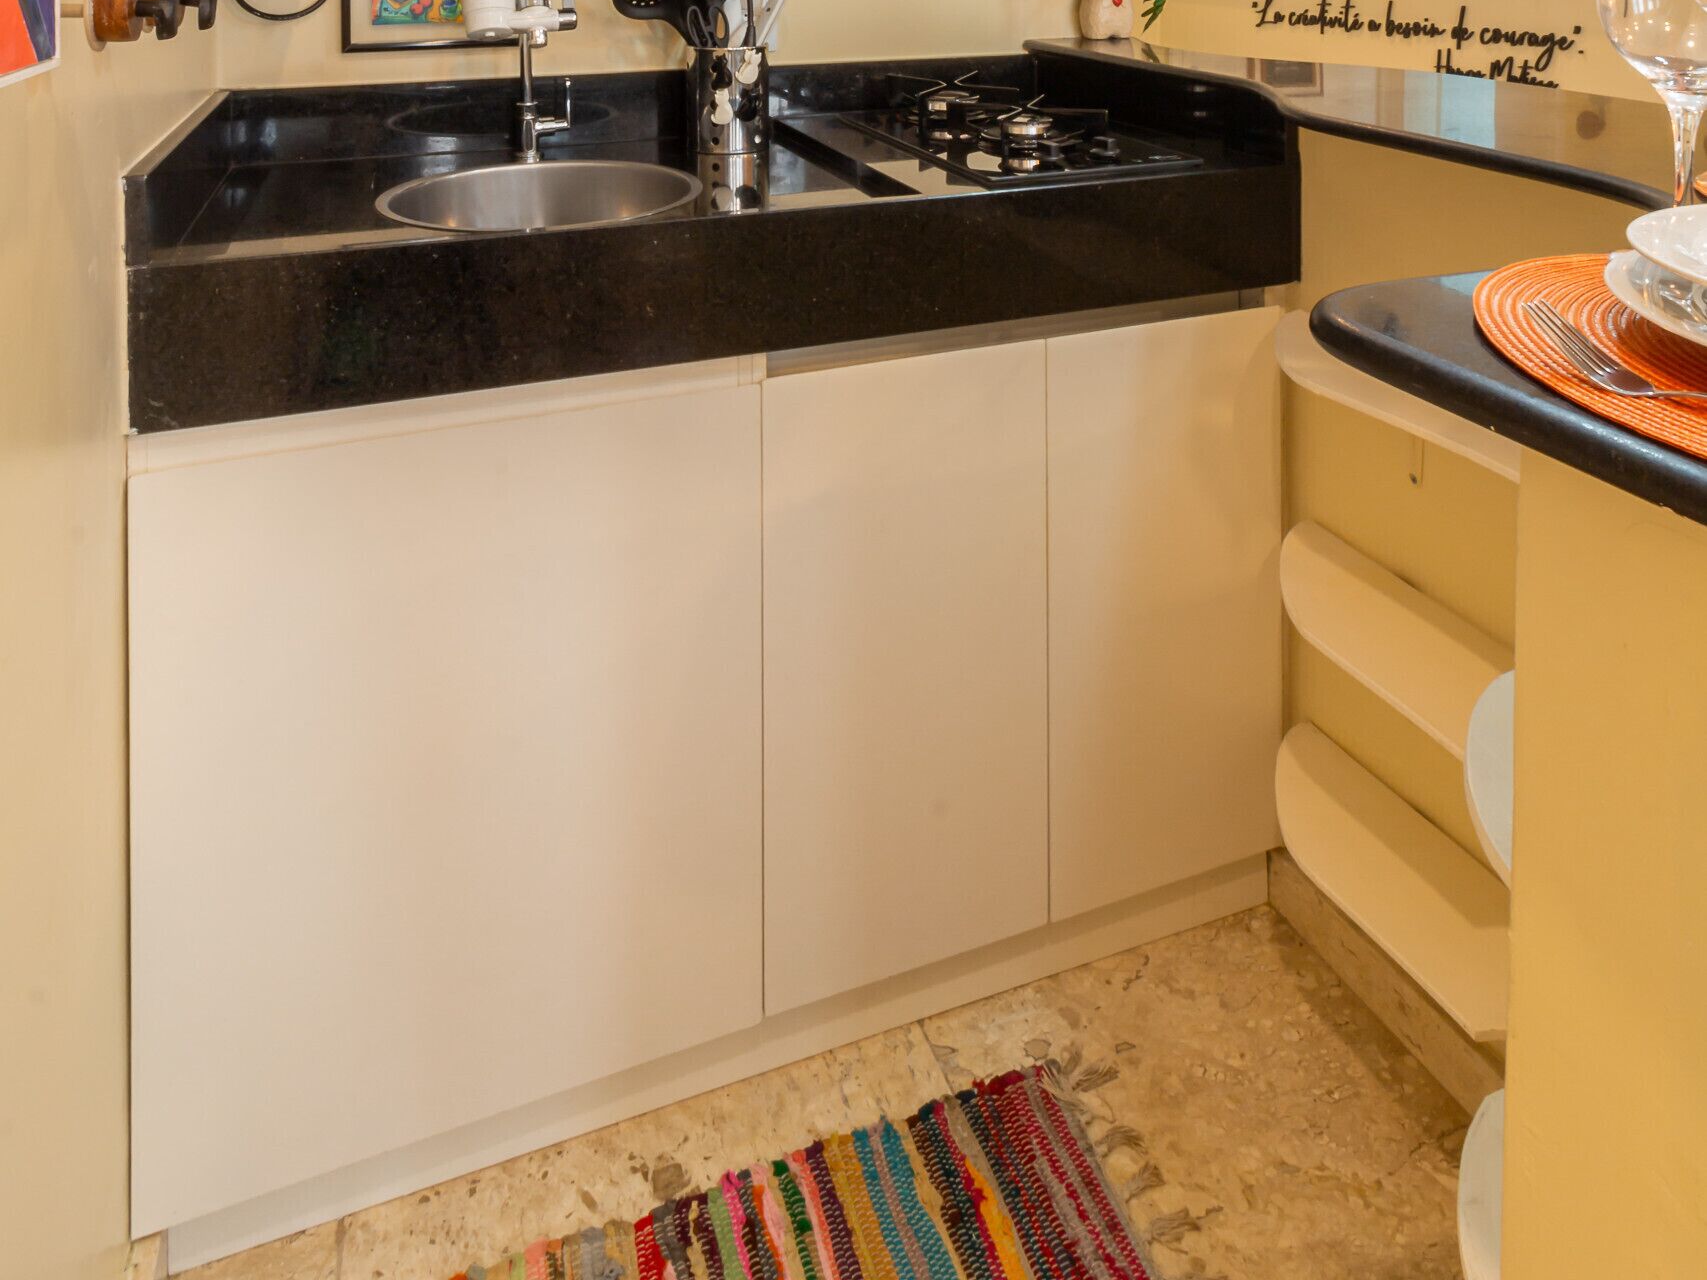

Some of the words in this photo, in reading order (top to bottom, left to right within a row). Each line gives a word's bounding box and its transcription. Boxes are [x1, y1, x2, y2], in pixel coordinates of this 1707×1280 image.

[1368, 19, 1381, 32] a
[1386, 0, 1446, 38] besoin
[1451, 5, 1474, 50] de
